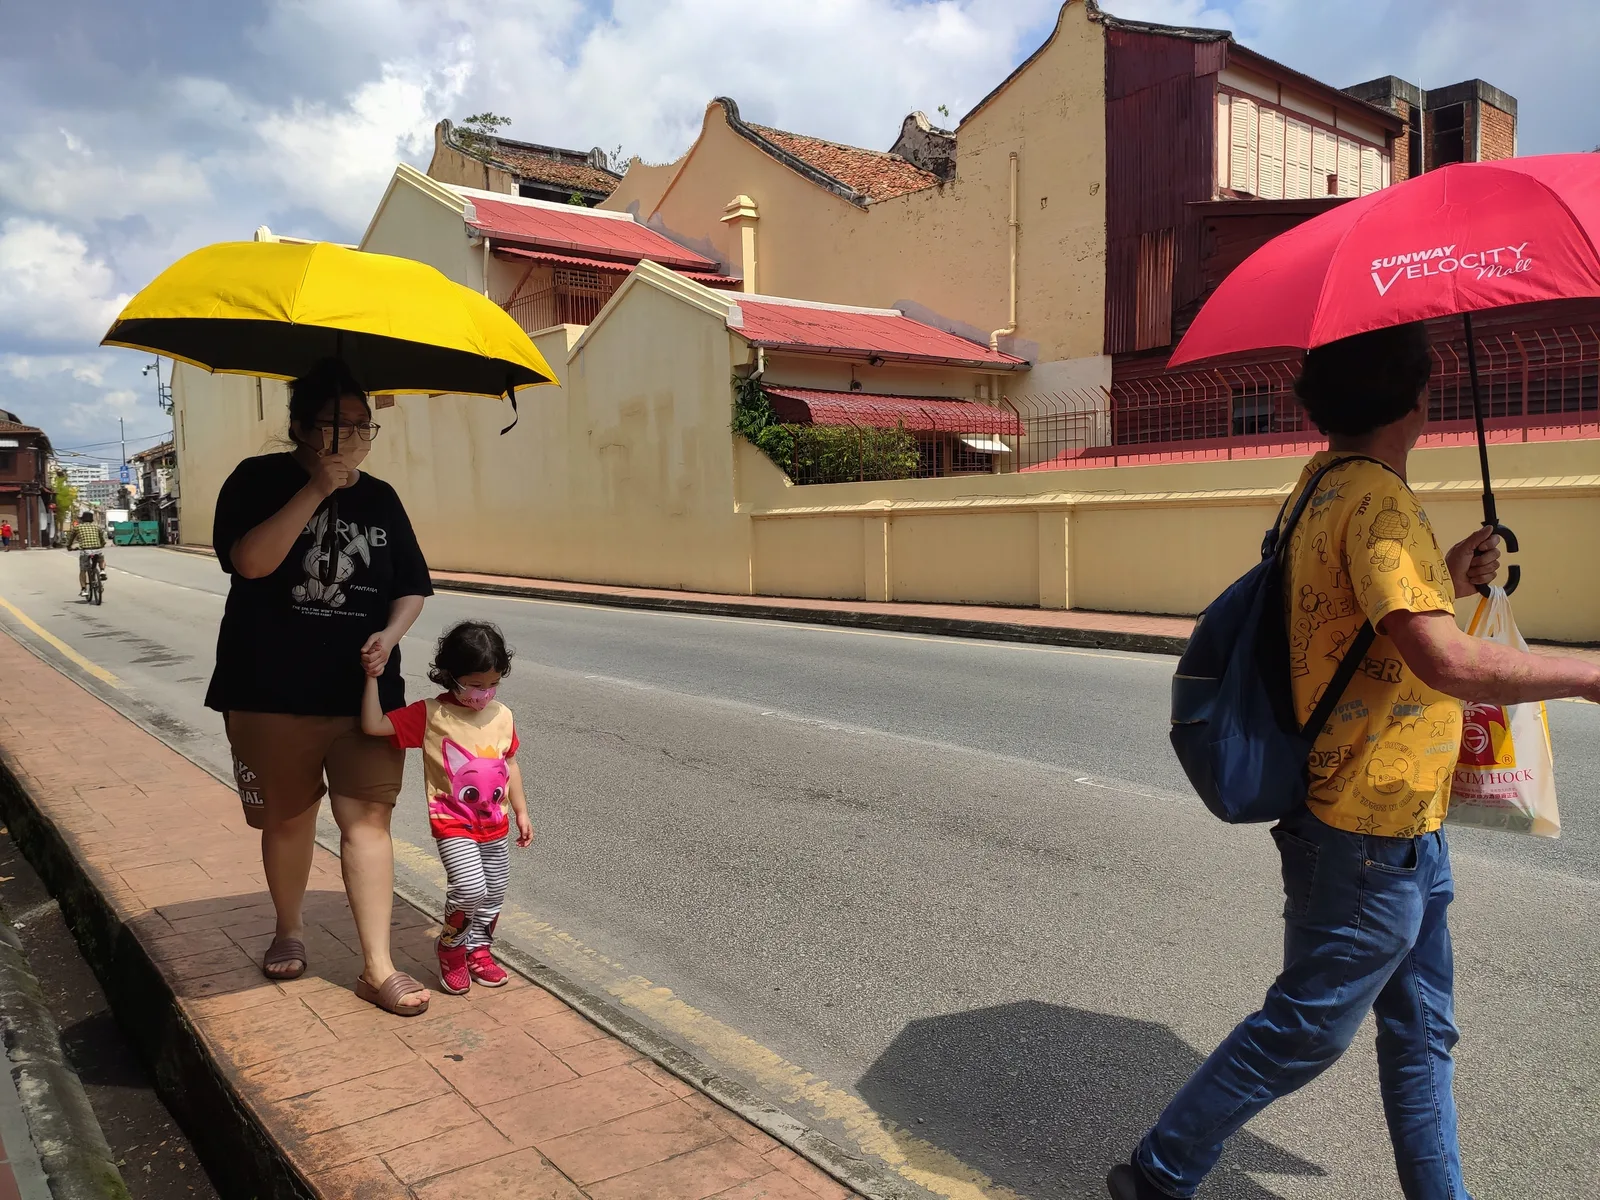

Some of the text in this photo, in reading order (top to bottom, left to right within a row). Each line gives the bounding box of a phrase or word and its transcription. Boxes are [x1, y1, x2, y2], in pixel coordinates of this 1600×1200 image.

[1371, 244, 1456, 270] SUNWAY
[1476, 258, 1532, 280] Mall
[1371, 242, 1528, 297] VELOCITY
[1454, 769, 1534, 785] KIM HOCK
